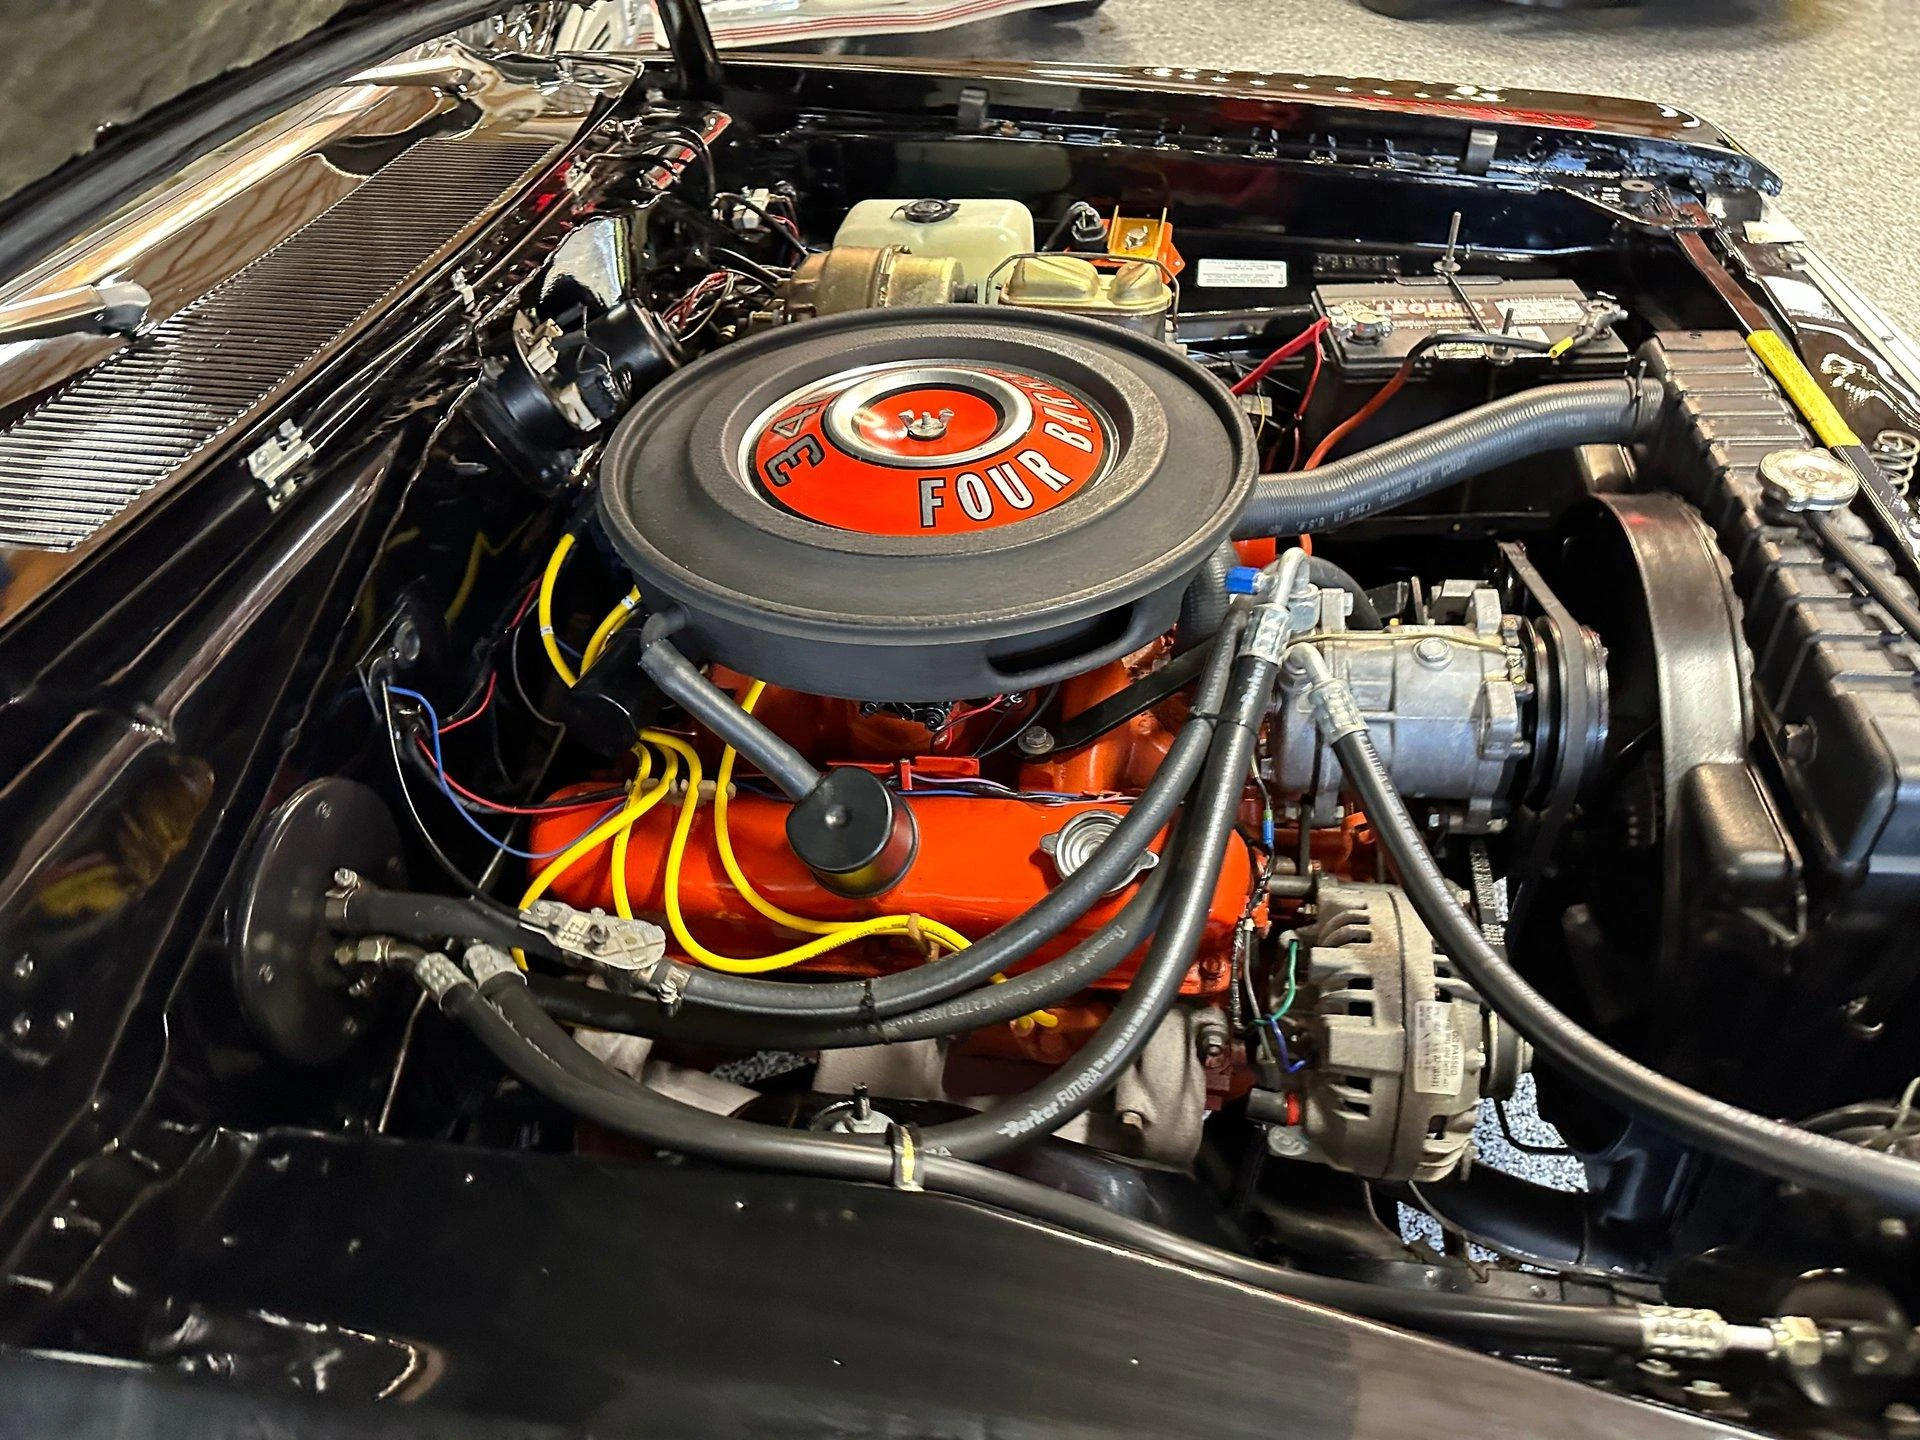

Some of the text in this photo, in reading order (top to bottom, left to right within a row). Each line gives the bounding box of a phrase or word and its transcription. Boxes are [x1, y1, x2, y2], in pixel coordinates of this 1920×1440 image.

[917, 448, 1073, 528] FOUR
[996, 1101, 1059, 1138] Parker
[1056, 1067, 1103, 1107] FUTURA
